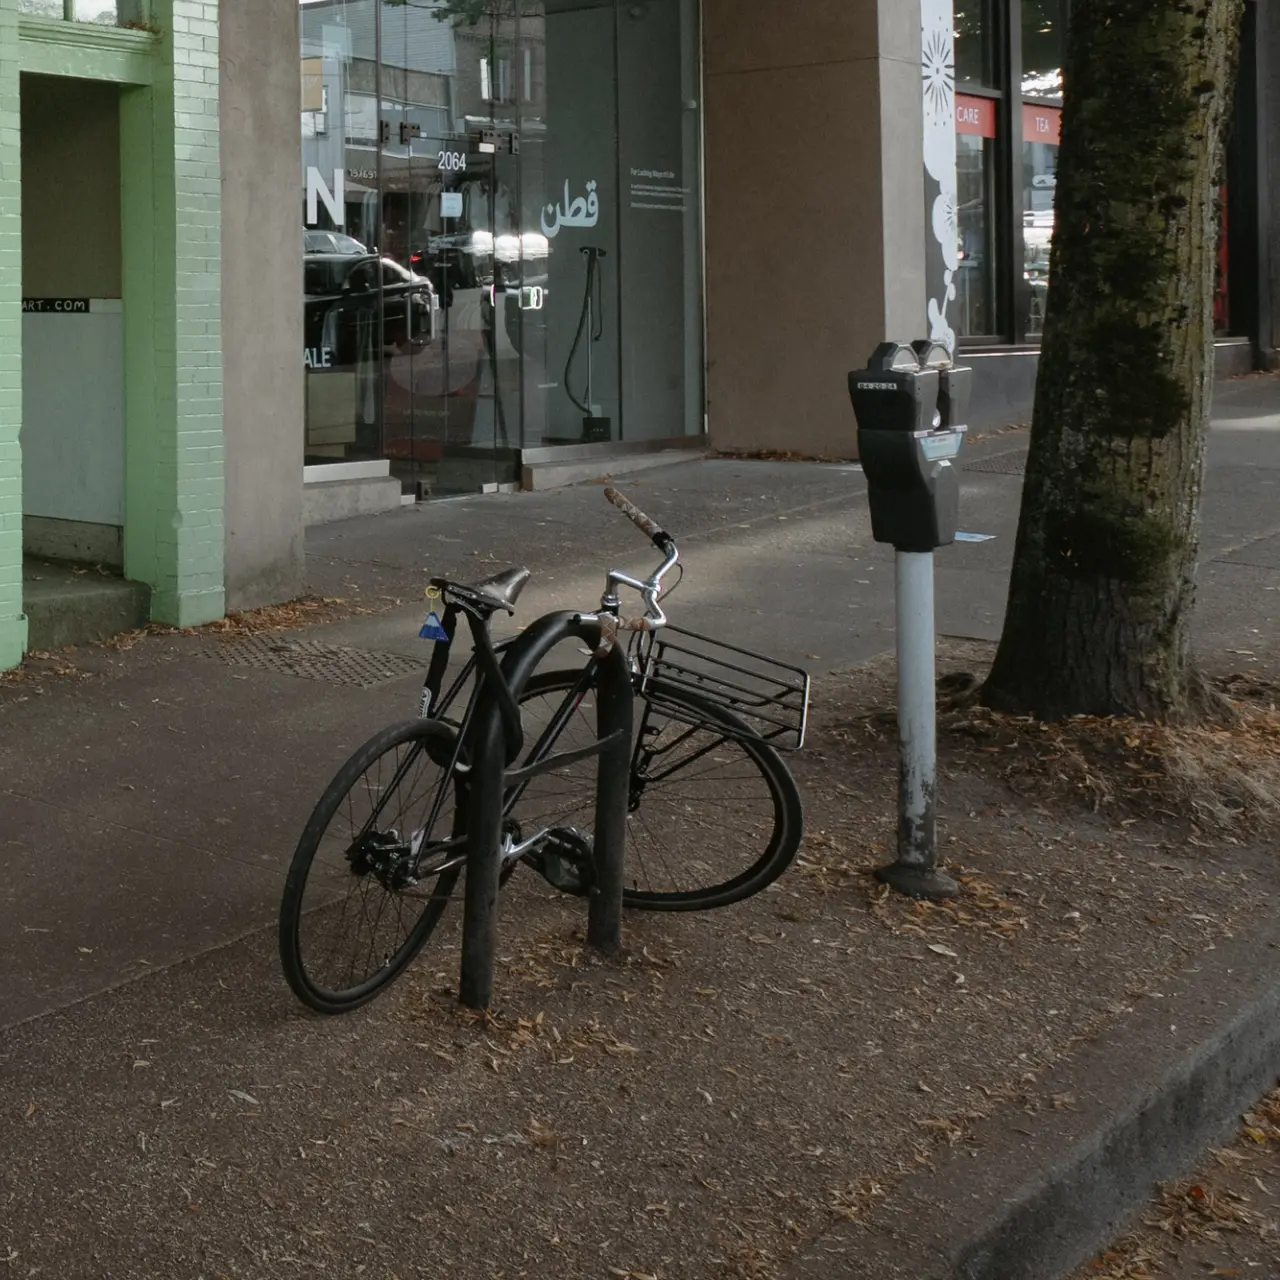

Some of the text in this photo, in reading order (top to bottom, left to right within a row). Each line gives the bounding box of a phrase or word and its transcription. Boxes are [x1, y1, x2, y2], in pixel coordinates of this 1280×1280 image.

[956, 106, 980, 124] CARE
[1035, 117, 1050, 133] TEA
[438, 151, 466, 171] 2064
[306, 166, 344, 226] N
[540, 178, 600, 238] قطن
[303, 347, 332, 368] ALE
